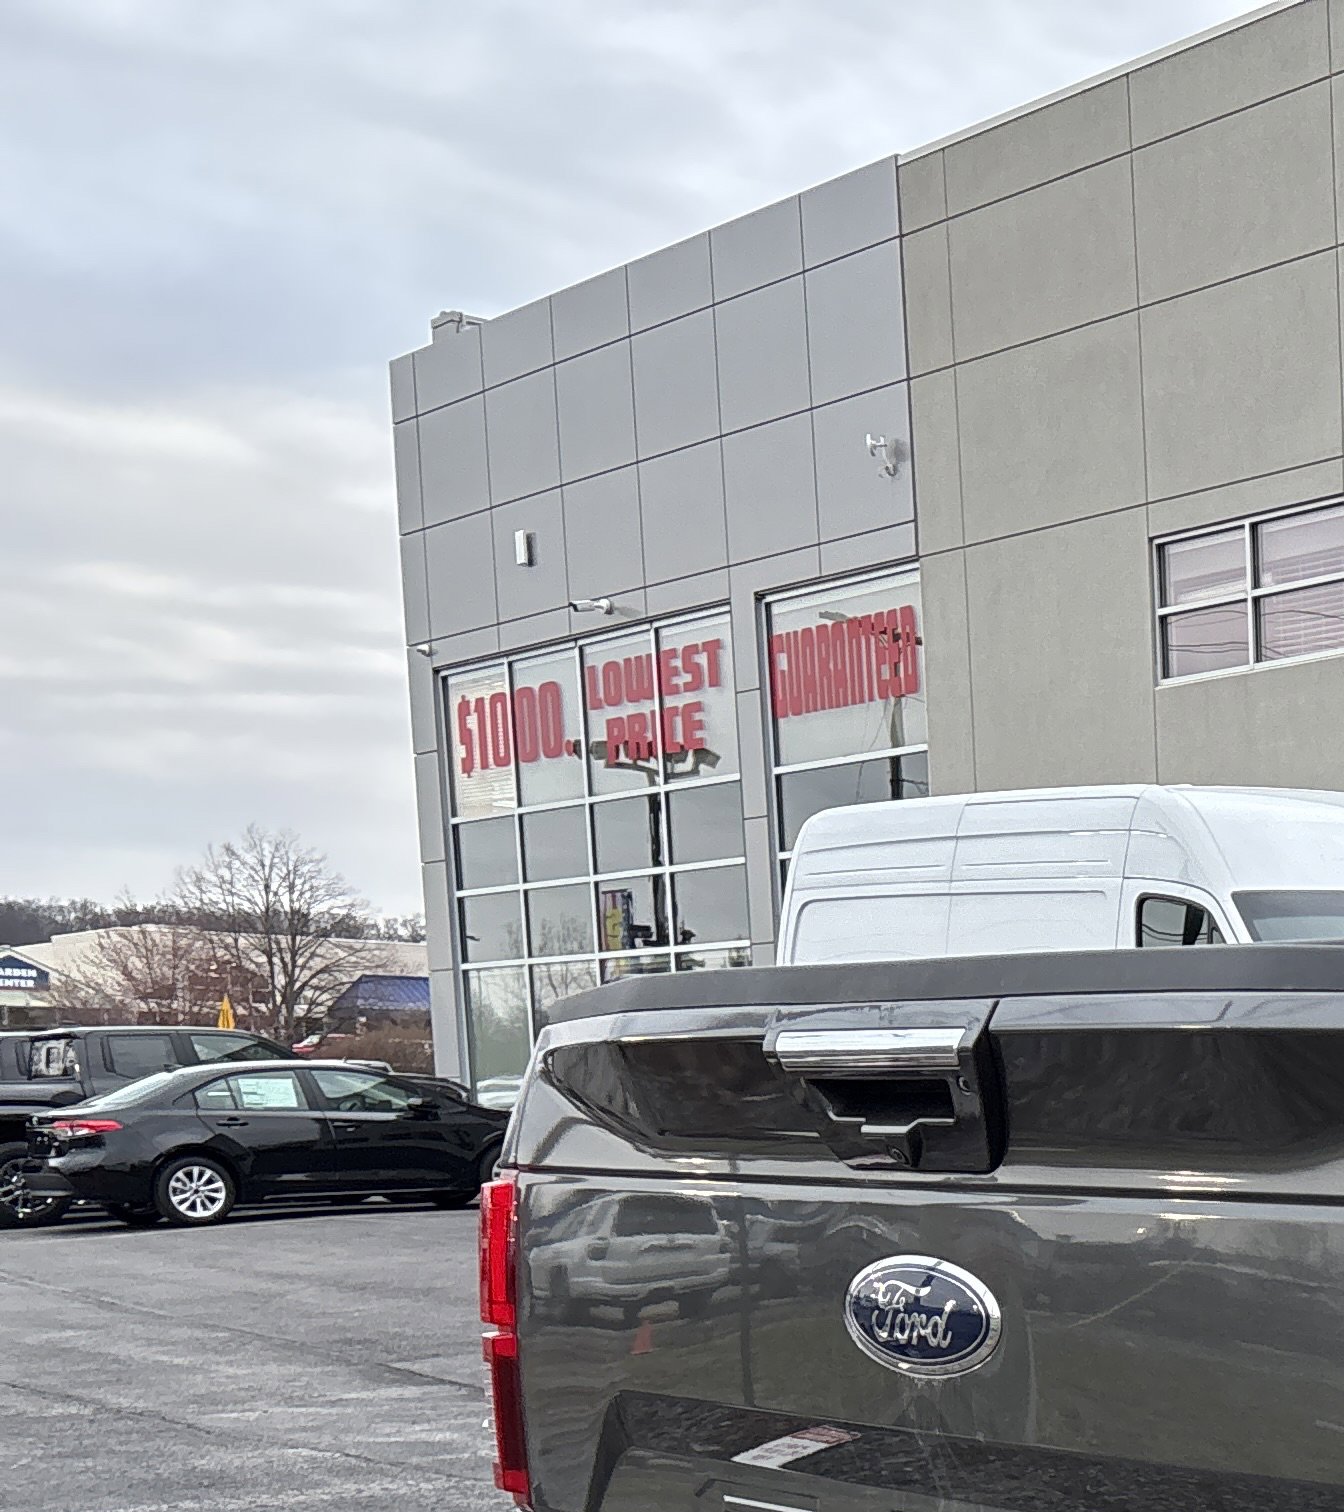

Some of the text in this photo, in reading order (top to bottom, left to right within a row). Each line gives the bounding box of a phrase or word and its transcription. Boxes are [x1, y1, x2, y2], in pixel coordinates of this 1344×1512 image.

[586, 638, 721, 710] LOWEST
[772, 605, 918, 718] GUARANTEED
[606, 701, 704, 767] PRICE
[871, 1280, 957, 1349] Ford
